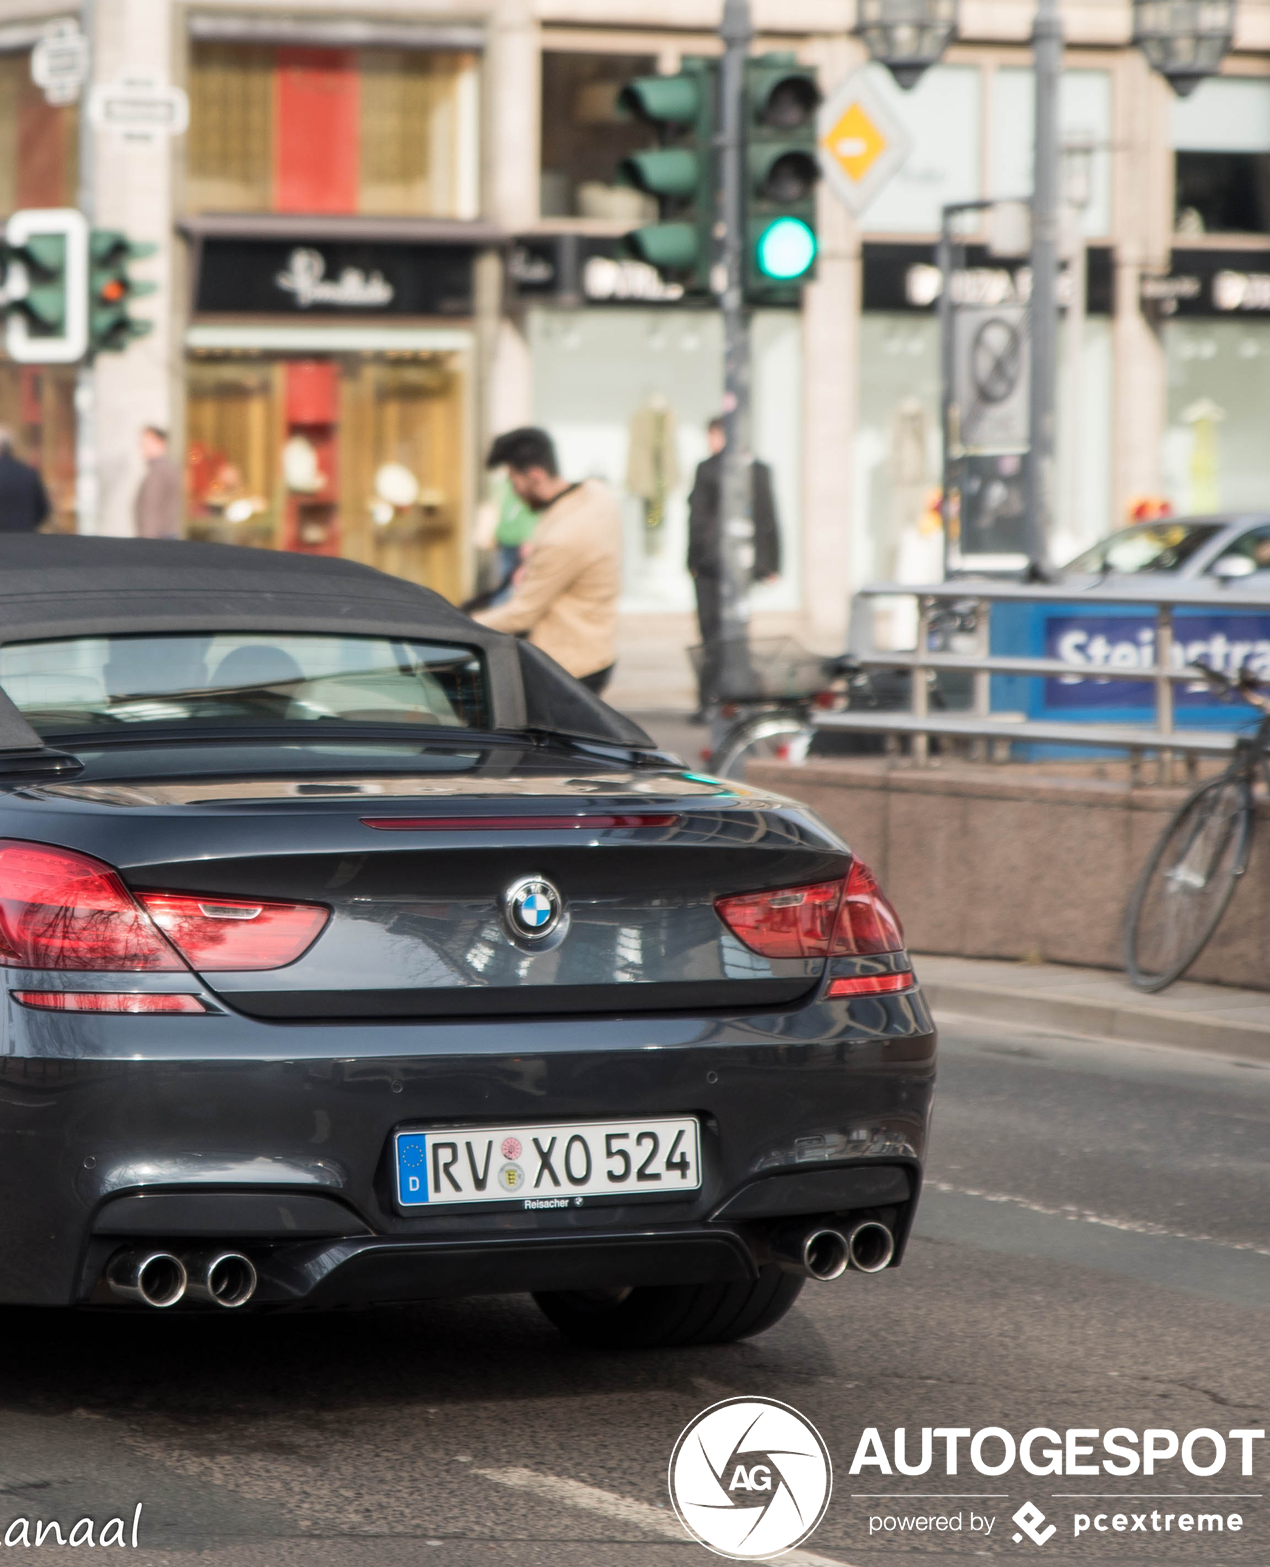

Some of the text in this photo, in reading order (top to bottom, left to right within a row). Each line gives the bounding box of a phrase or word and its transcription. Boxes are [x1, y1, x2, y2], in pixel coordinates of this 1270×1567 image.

[408, 1175, 420, 1192] D
[432, 1140, 493, 1193] RV
[532, 1134, 591, 1187] XO
[605, 1129, 690, 1183] 524
[524, 1198, 569, 1210] Reisacher
